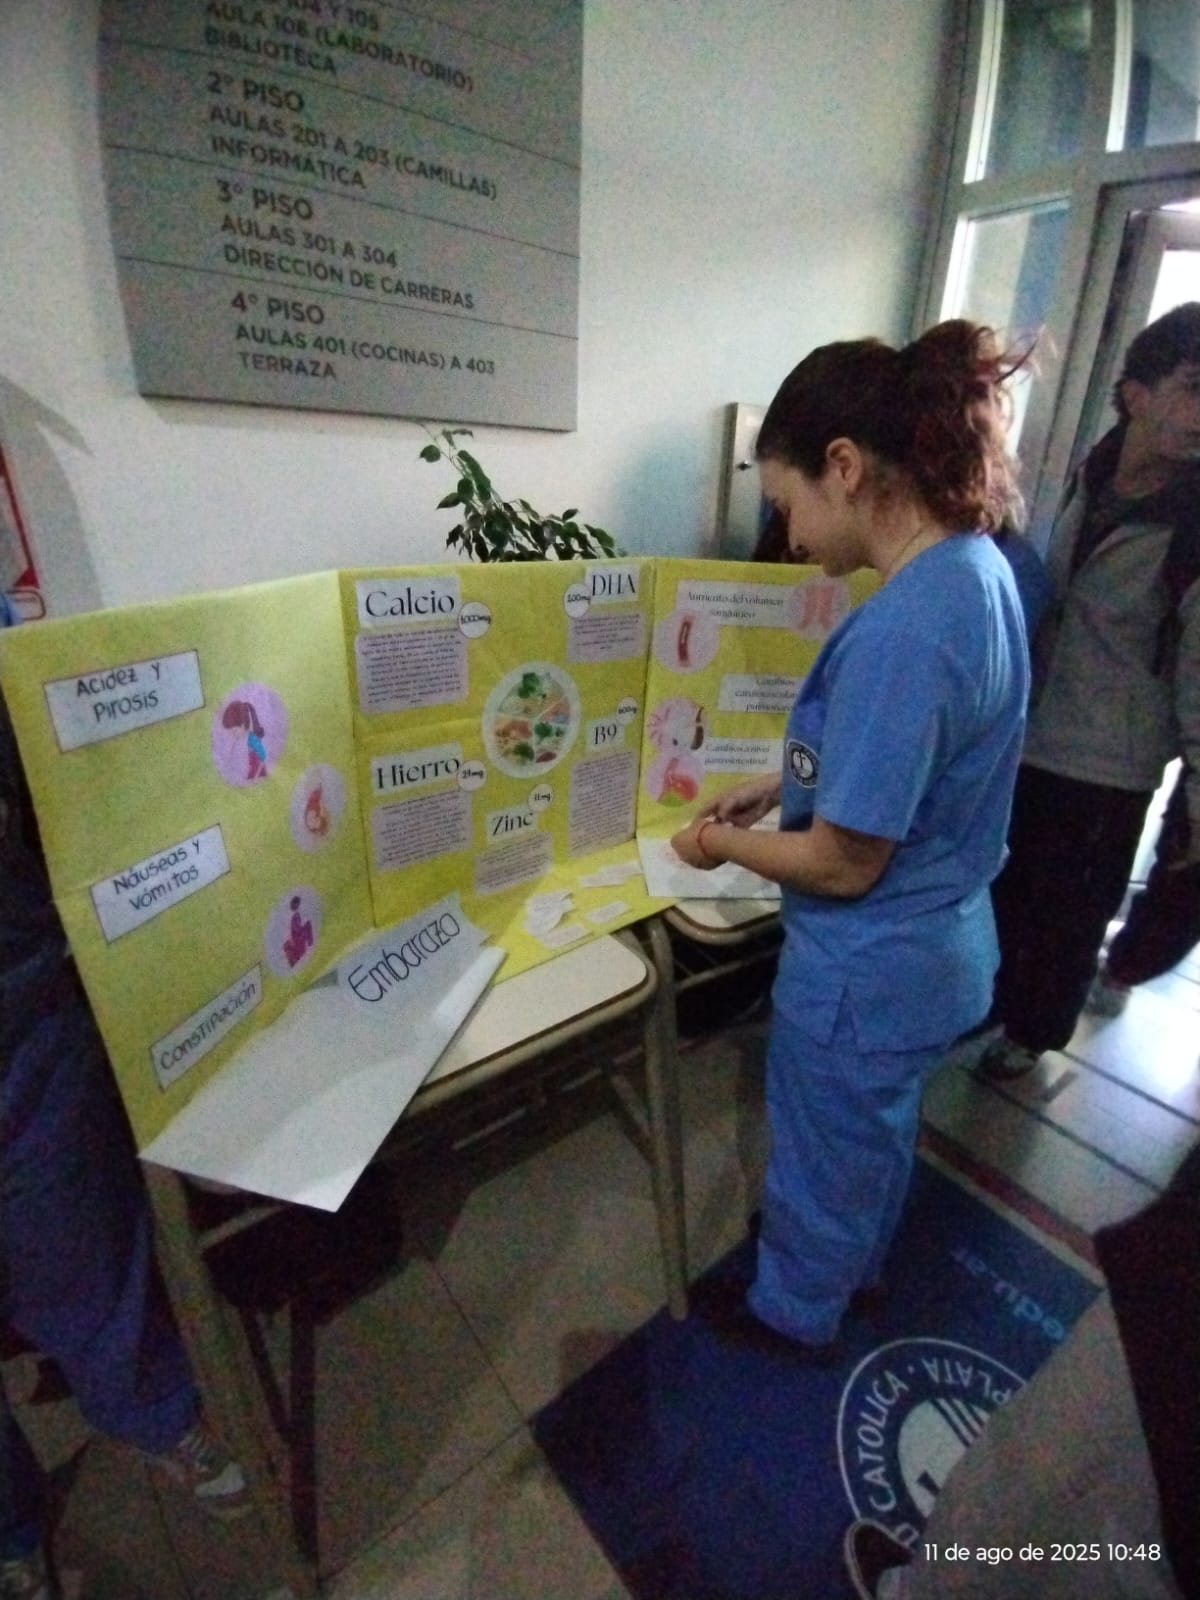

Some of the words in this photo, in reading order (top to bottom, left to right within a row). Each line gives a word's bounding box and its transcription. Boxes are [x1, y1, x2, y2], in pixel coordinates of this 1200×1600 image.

[205, 25, 337, 76] BIBLIOTECA
[206, 1, 268, 30] AULA
[315, 26, 473, 92] (LABORATORIO)
[243, 79, 305, 112] PISO
[210, 106, 287, 138] AULAS
[293, 123, 327, 150] 201
[334, 136, 348, 156] A
[354, 139, 389, 168] 203
[395, 153, 497, 201] (CAMILLAS)
[253, 187, 314, 220] PISO
[221, 214, 296, 246] AULAS
[302, 231, 337, 255] 301
[342, 241, 356, 260] A
[362, 245, 398, 268] 304
[350, 270, 376, 290] DE
[381, 276, 475, 309] CARRERAS
[267, 297, 325, 325] PISO
[236, 323, 307, 350] AULAS
[313, 335, 346, 356] 401
[351, 341, 445, 371] (COCINAS)
[451, 355, 462, 371] A
[466, 358, 496, 375] 403
[238, 352, 337, 379] TERRAZA
[365, 586, 455, 618] Calcio
[592, 573, 637, 596] DHA
[377, 758, 460, 789] Hierro
[492, 812, 534, 837] Zinc
[347, 912, 460, 1002] Embarazo
[921, 1357, 1013, 1407] PLATA
[857, 1369, 910, 1513] CATOLICA
